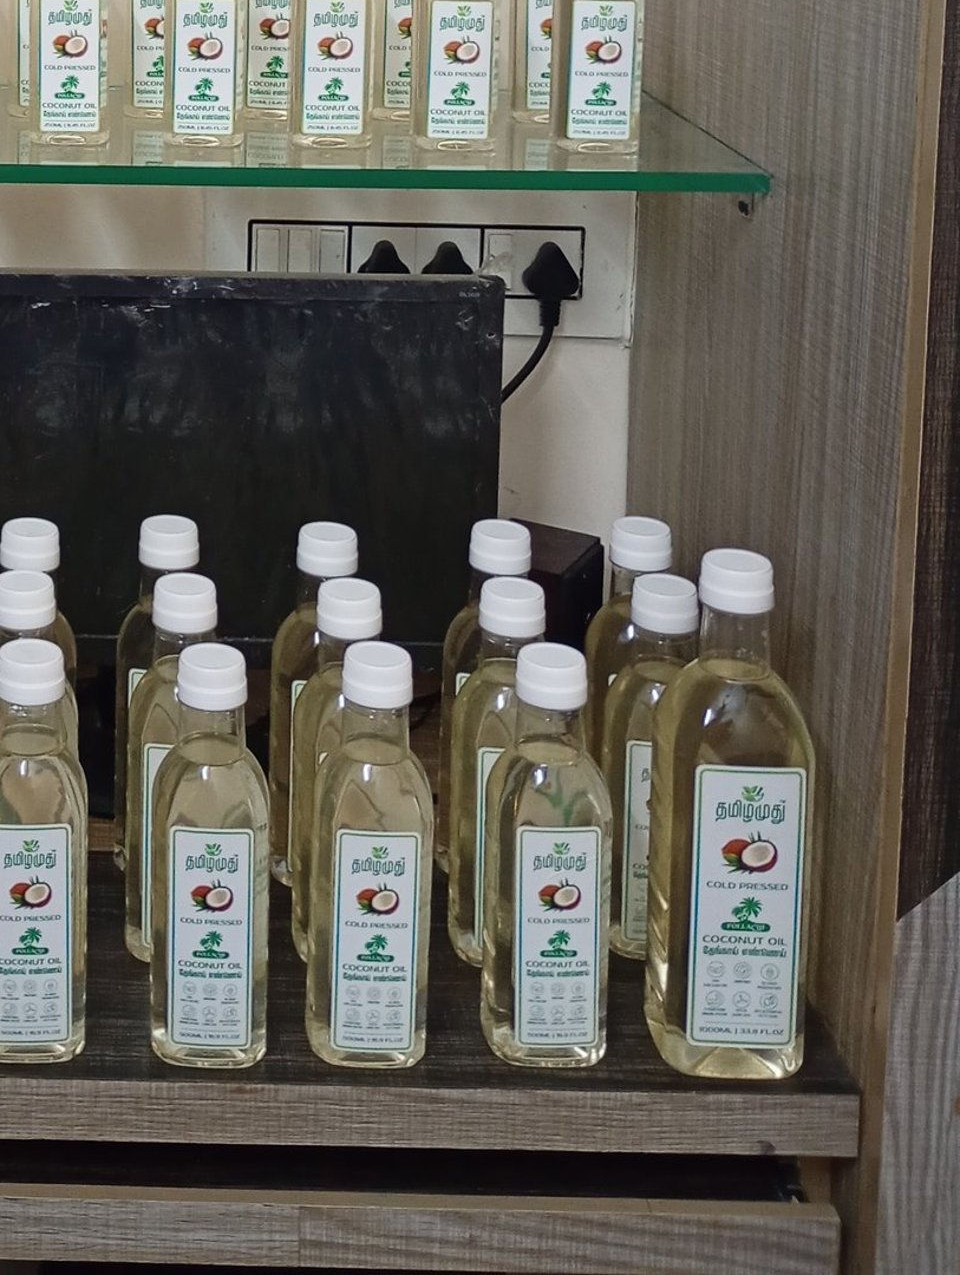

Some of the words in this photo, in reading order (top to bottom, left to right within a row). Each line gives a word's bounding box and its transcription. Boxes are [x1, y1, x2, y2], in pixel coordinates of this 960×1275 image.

[706, 878, 735, 889] COLD
[739, 880, 788, 892] PRESSED
[0, 914, 21, 922] COLD
[180, 916, 202, 925] COLD
[204, 917, 242, 927] PRESSED
[527, 916, 550, 924] COLD
[345, 919, 367, 928] COLD
[370, 921, 407, 930] PRESSED
[702, 933, 764, 946] COCONUT
[767, 937, 787, 946] OIL
[178, 959, 225, 969] COCONUT
[227, 962, 242, 970] OIL
[342, 963, 390, 973] COCONUT
[525, 960, 573, 968] COCONUT
